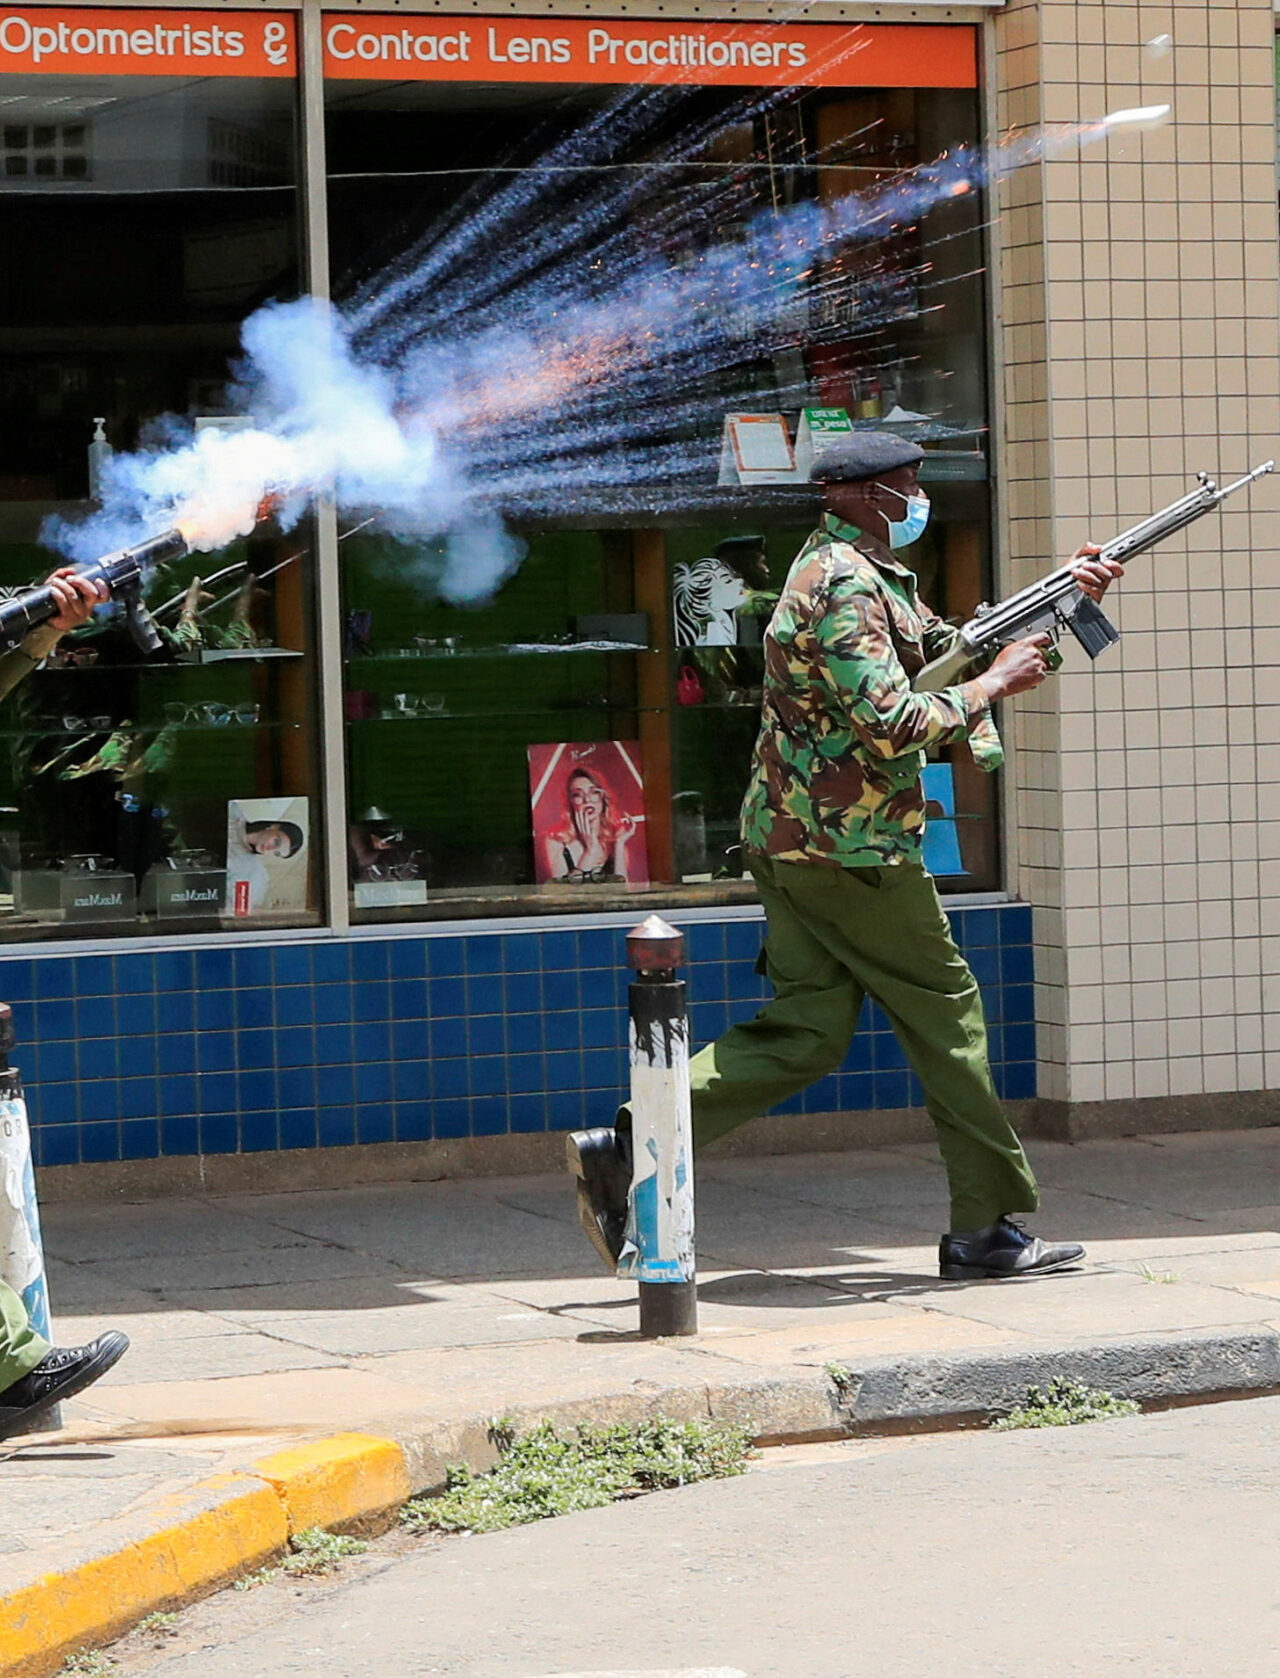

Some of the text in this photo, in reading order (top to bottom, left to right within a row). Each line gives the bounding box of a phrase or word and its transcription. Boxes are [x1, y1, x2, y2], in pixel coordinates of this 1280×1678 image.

[0, 16, 808, 68] Optometrists & Contact Lens Practitioners
